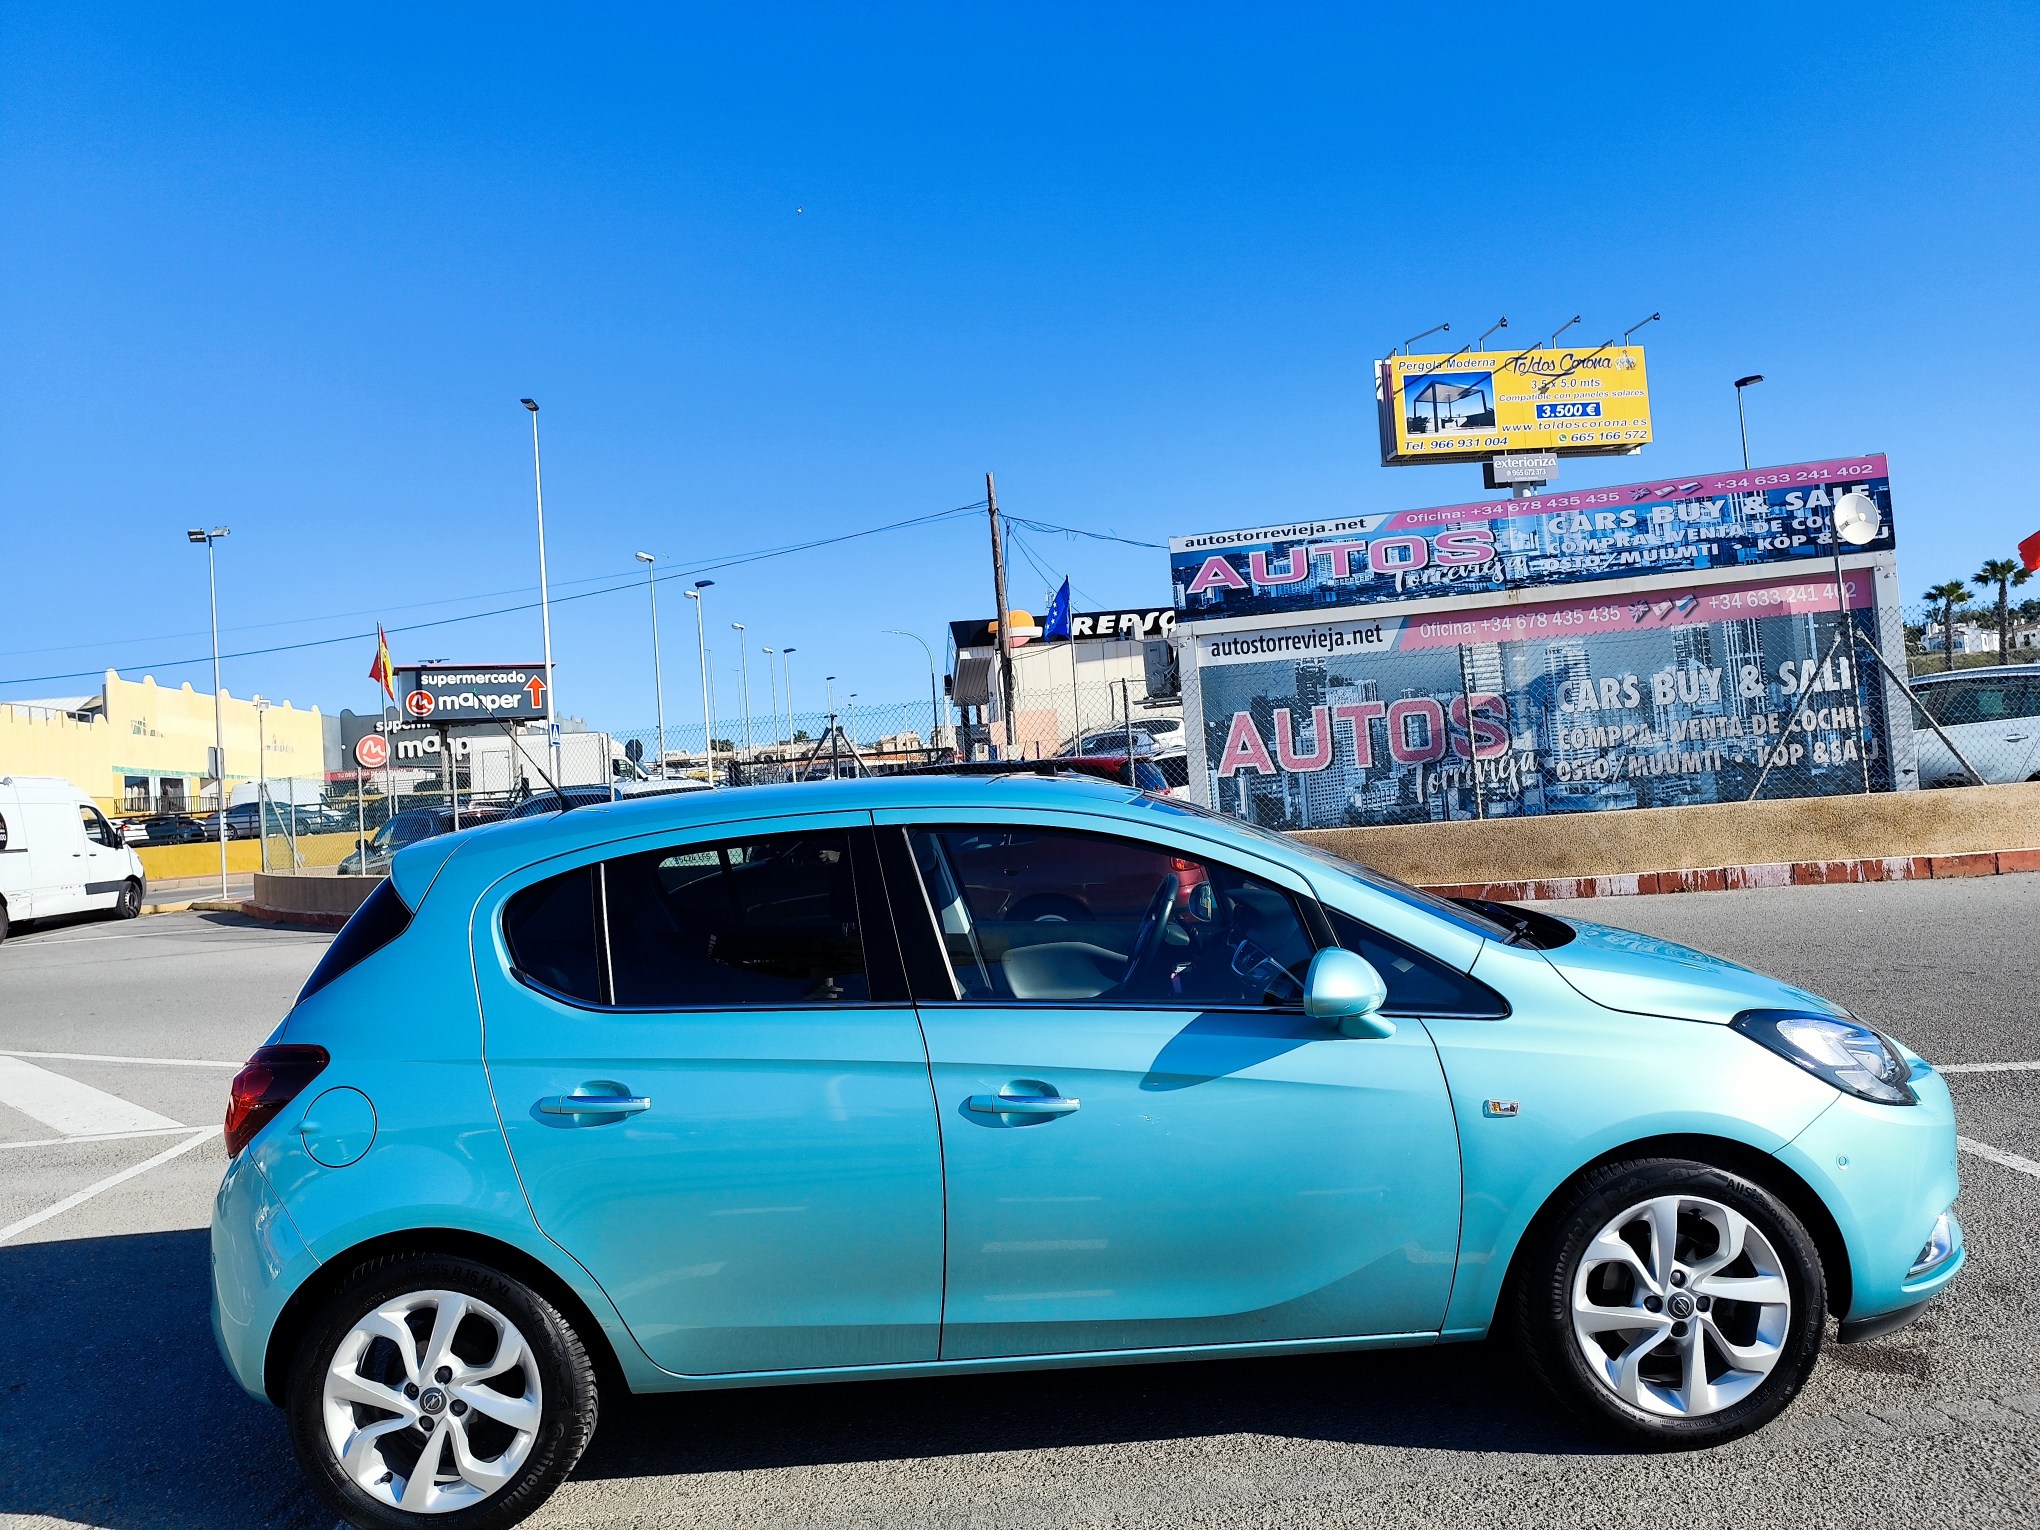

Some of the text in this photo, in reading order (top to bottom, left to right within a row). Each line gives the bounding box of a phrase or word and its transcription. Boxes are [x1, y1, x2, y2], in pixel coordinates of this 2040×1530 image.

[1446, 359, 1496, 368] Moderna
[1505, 353, 1612, 376] Toldos Corona
[1499, 390, 1551, 402] Compatible
[1574, 391, 1609, 400] paneles
[1612, 389, 1645, 397] solares
[1541, 403, 1597, 418] 3.500 €
[1501, 419, 1647, 432] www.toldoscorona.es
[1571, 430, 1648, 442] 665 166 572
[1404, 437, 1508, 451] Tel. 966 931 004
[1494, 456, 1557, 468] exterioriza
[1714, 464, 1873, 489] +34 633 241 402
[1406, 491, 1620, 524] Oficina: +34 678 435 435
[1549, 509, 1638, 535] CARS
[1652, 500, 1727, 524] BUY
[1743, 496, 1771, 515] &
[1185, 518, 1367, 547] autostorrevieja.net
[1548, 534, 1648, 554] COMPRA
[1671, 522, 1746, 542] VENTA
[1754, 520, 1783, 533] DE
[1187, 529, 1498, 594] AUTOS
[1393, 555, 1530, 592] Torrevieja
[1709, 595, 1743, 610] +34
[1747, 588, 1781, 607] 633
[1785, 584, 1819, 603] 241
[1419, 605, 1621, 637] Oficina: +34 678 435 435
[1211, 624, 1383, 657] autostorrevieja.net
[420, 670, 526, 688] supermercado
[1557, 675, 1641, 712] CARS
[1653, 667, 1723, 705] BUY
[1739, 664, 1767, 698] &
[438, 692, 522, 714] manper
[1217, 691, 1512, 778] AUTOS
[1558, 723, 1653, 750] COMPRA
[1671, 715, 1745, 742] VENTA
[1751, 713, 1780, 736] DE
